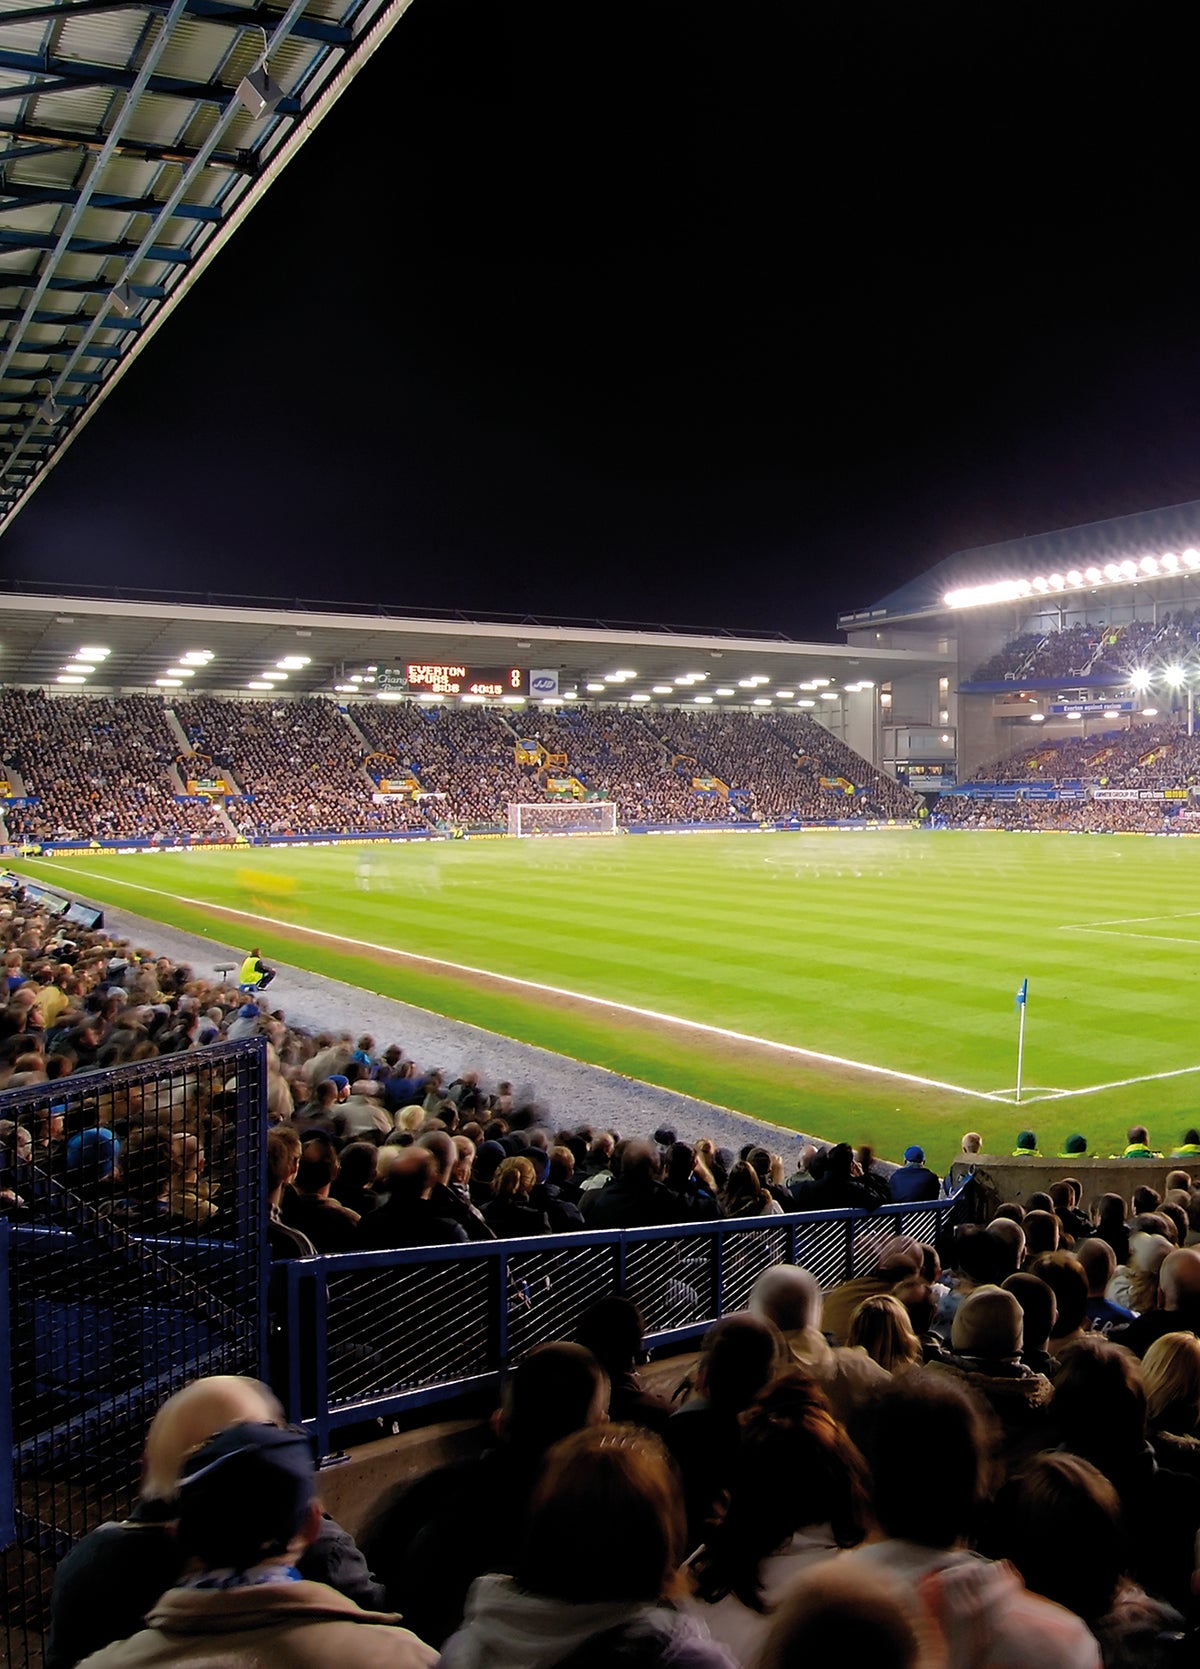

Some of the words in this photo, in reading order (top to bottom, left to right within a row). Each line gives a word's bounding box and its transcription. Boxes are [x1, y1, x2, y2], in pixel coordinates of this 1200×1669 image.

[408, 665, 466, 677] EVERTON
[408, 674, 449, 684] SPURS
[1084, 704, 1103, 712] against
